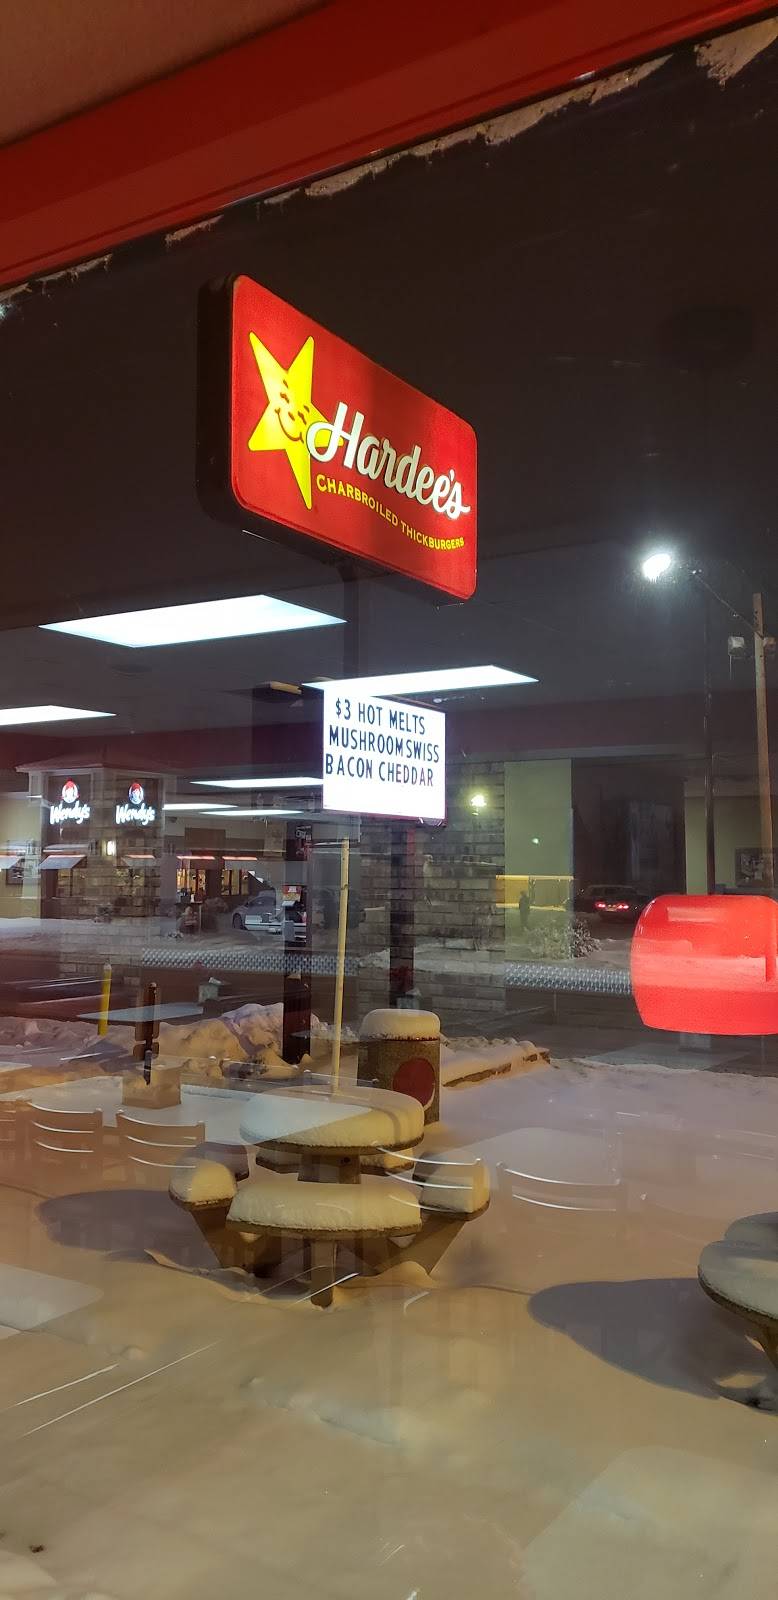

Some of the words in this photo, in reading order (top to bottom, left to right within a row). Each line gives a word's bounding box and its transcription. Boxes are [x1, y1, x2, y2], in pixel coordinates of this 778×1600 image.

[306, 401, 471, 519] Hardee's
[316, 474, 399, 527] CHARBROILED
[401, 520, 465, 550] THICKBURGERS
[335, 697, 351, 720] $3
[358, 702, 383, 726] HOT
[389, 709, 425, 735] MELTS
[325, 753, 373, 779] BACON
[379, 761, 434, 787] CHEDDAR
[50, 801, 91, 825] Wendy's
[115, 803, 156, 826] Wendy's
